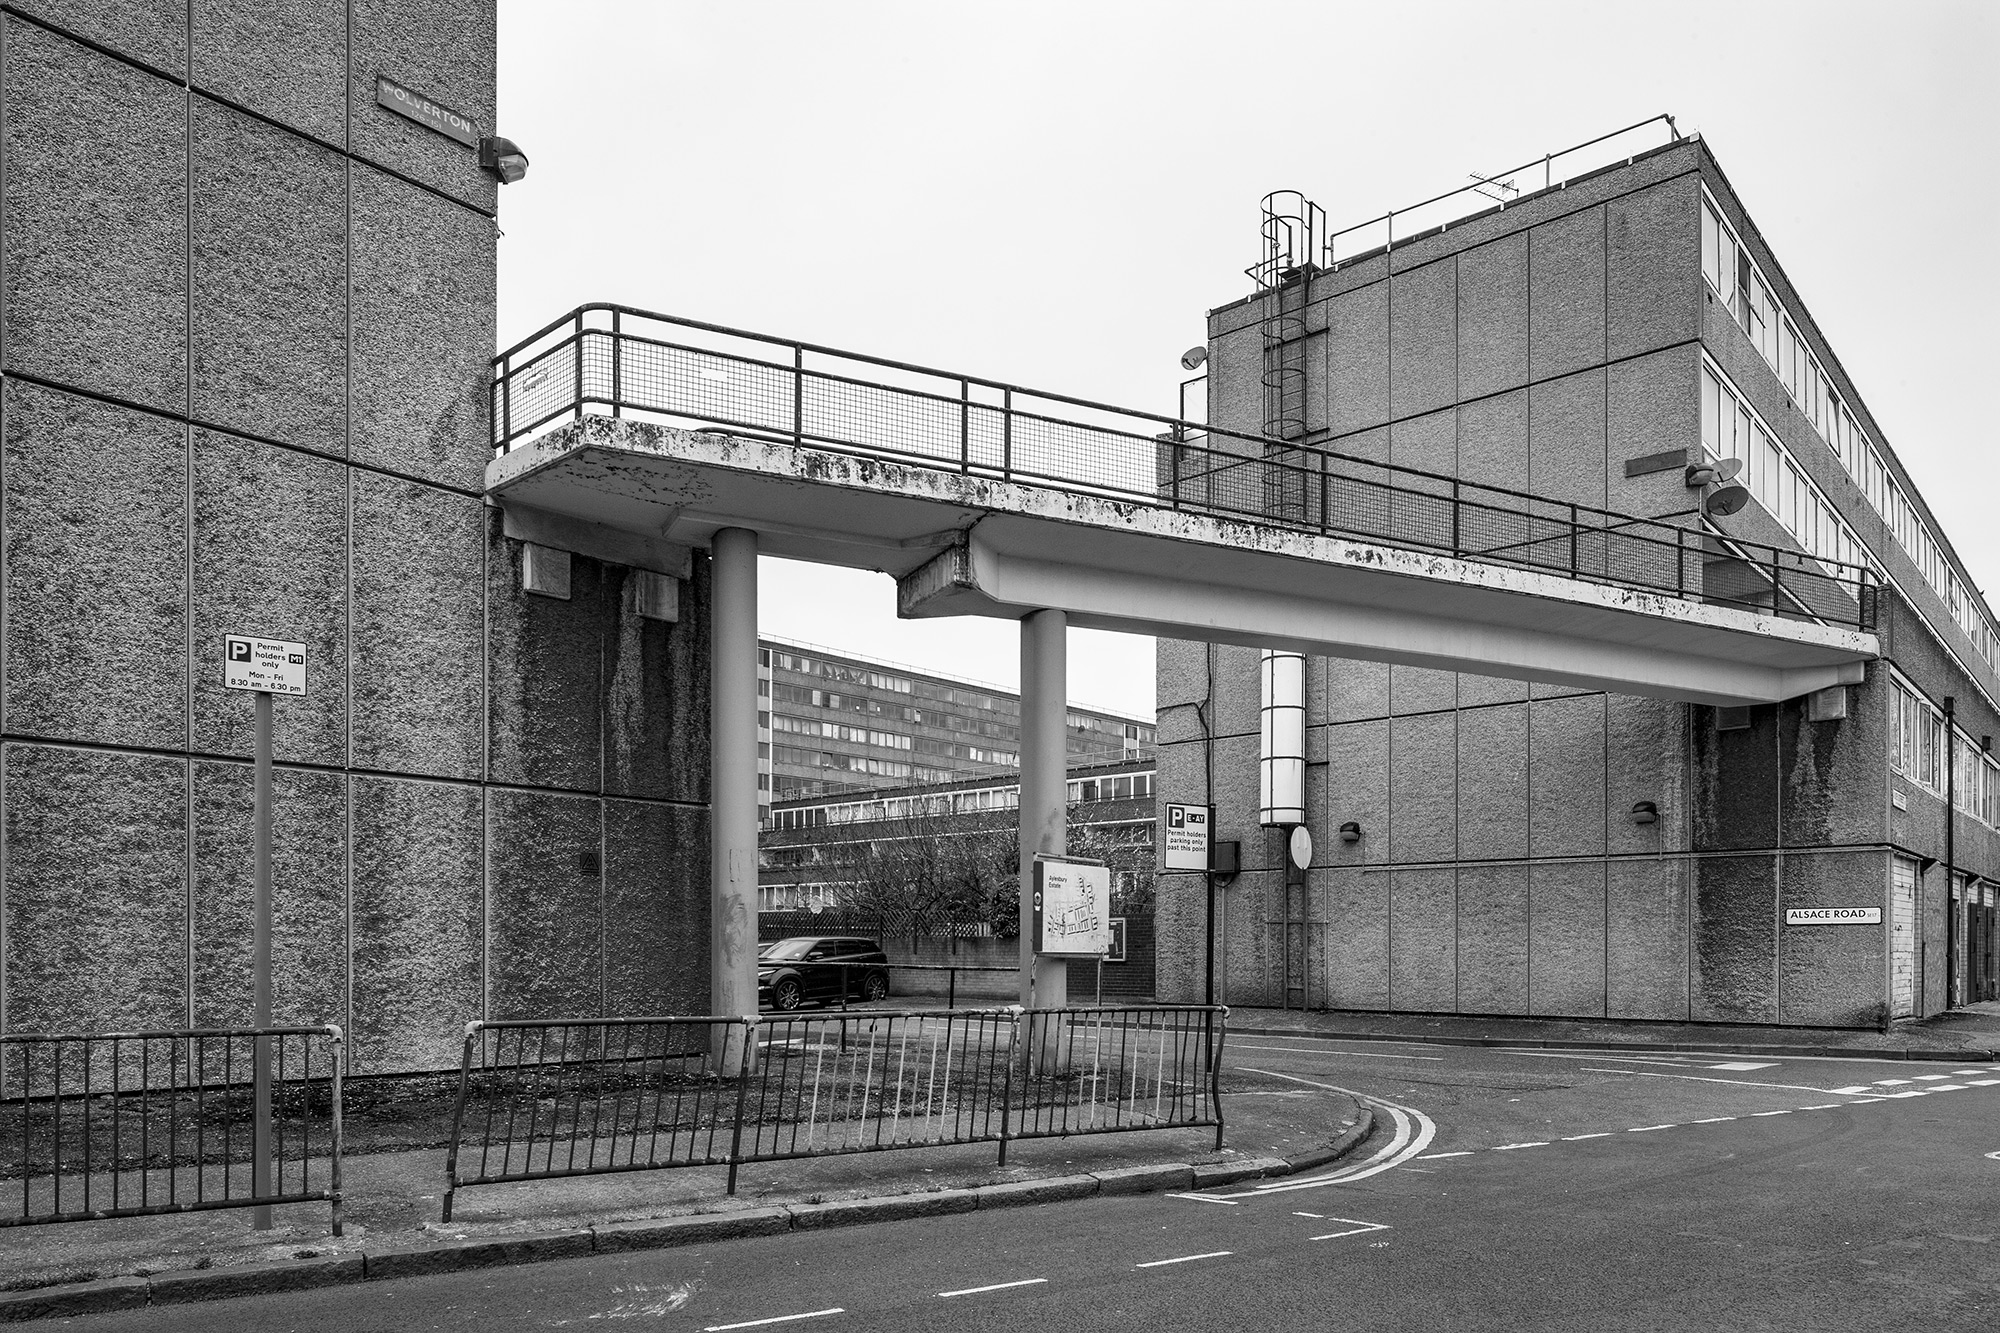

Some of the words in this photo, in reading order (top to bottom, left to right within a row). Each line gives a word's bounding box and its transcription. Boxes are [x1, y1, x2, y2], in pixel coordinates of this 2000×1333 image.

[232, 642, 248, 660] P
[257, 643, 284, 652] Permit
[255, 651, 286, 661] holders
[261, 661, 279, 669] only
[248, 671, 265, 679] Mon
[230, 678, 248, 687] 8.30
[270, 682, 288, 691] 6.30
[1172, 808, 1183, 826] P
[1168, 829, 1186, 837] Permit
[1790, 910, 1831, 919] ALSACE
[1833, 909, 1866, 919] ROAD
